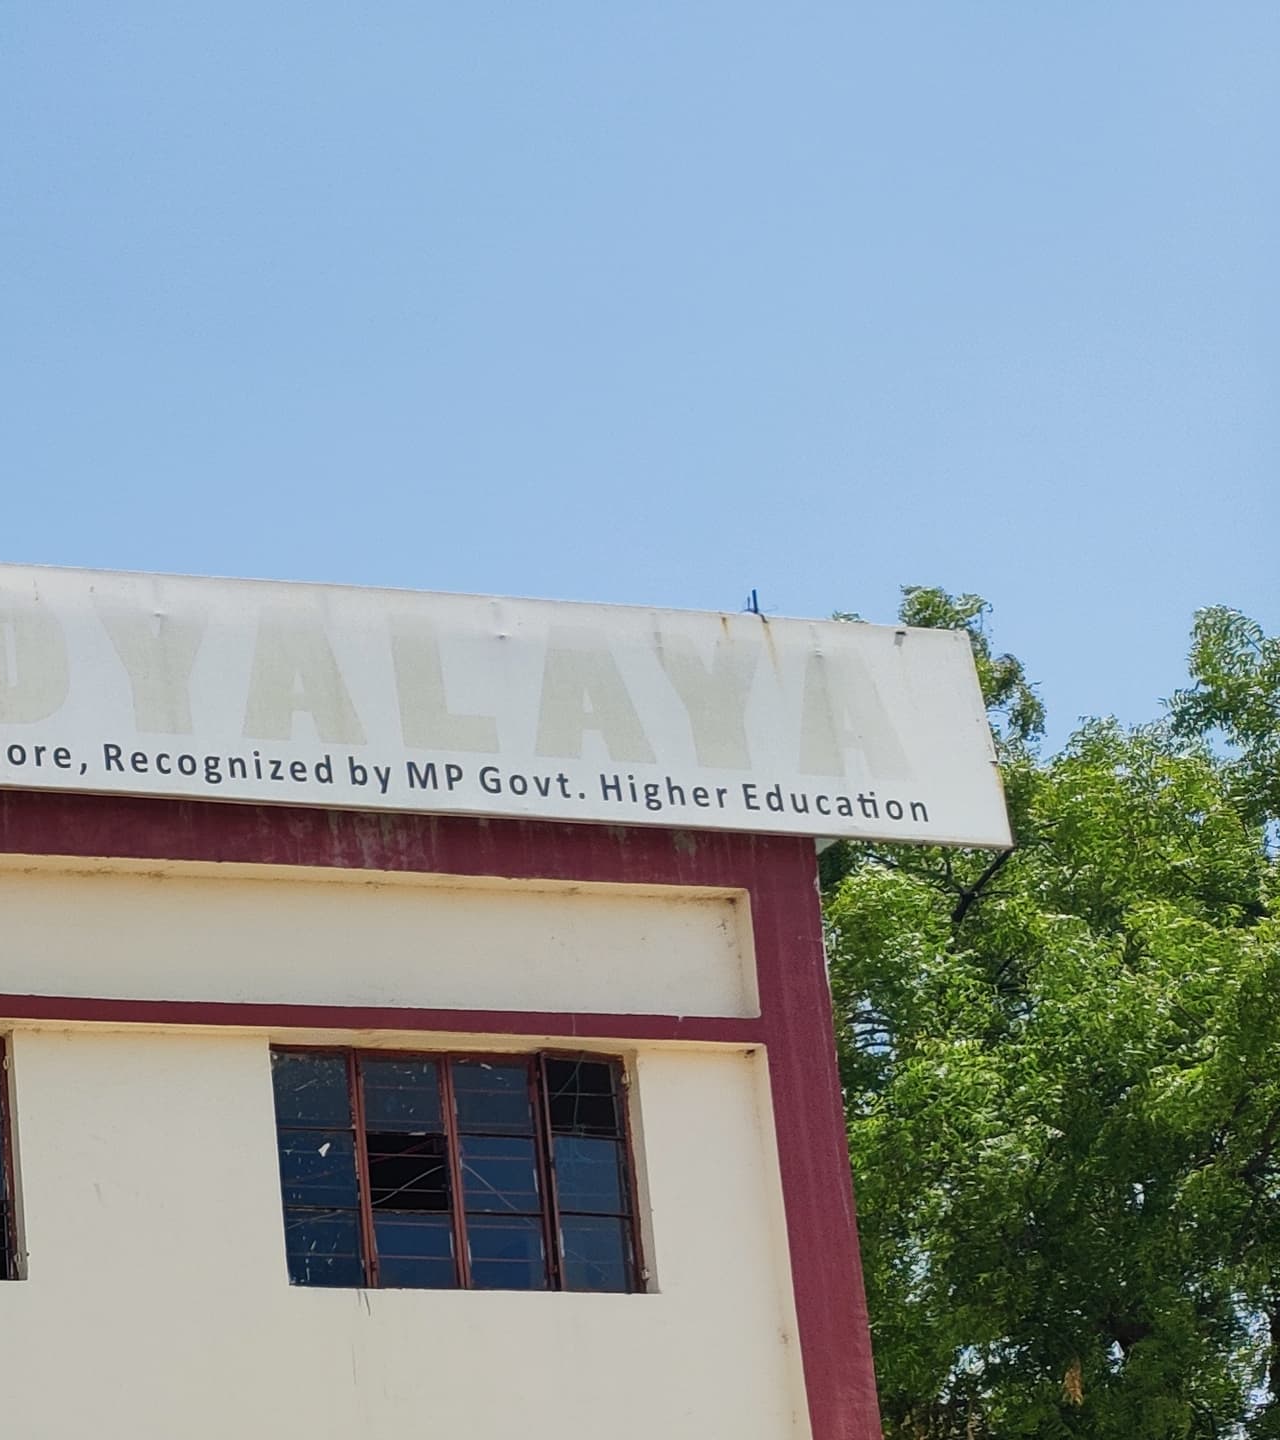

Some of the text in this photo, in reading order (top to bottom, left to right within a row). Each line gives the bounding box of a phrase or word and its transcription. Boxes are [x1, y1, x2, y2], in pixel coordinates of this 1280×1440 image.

[103, 743, 333, 785] Recognized
[348, 756, 391, 794] by
[406, 761, 463, 791] MP
[479, 766, 585, 800] Govt.
[599, 774, 727, 811] Higher
[742, 783, 929, 822] Education
